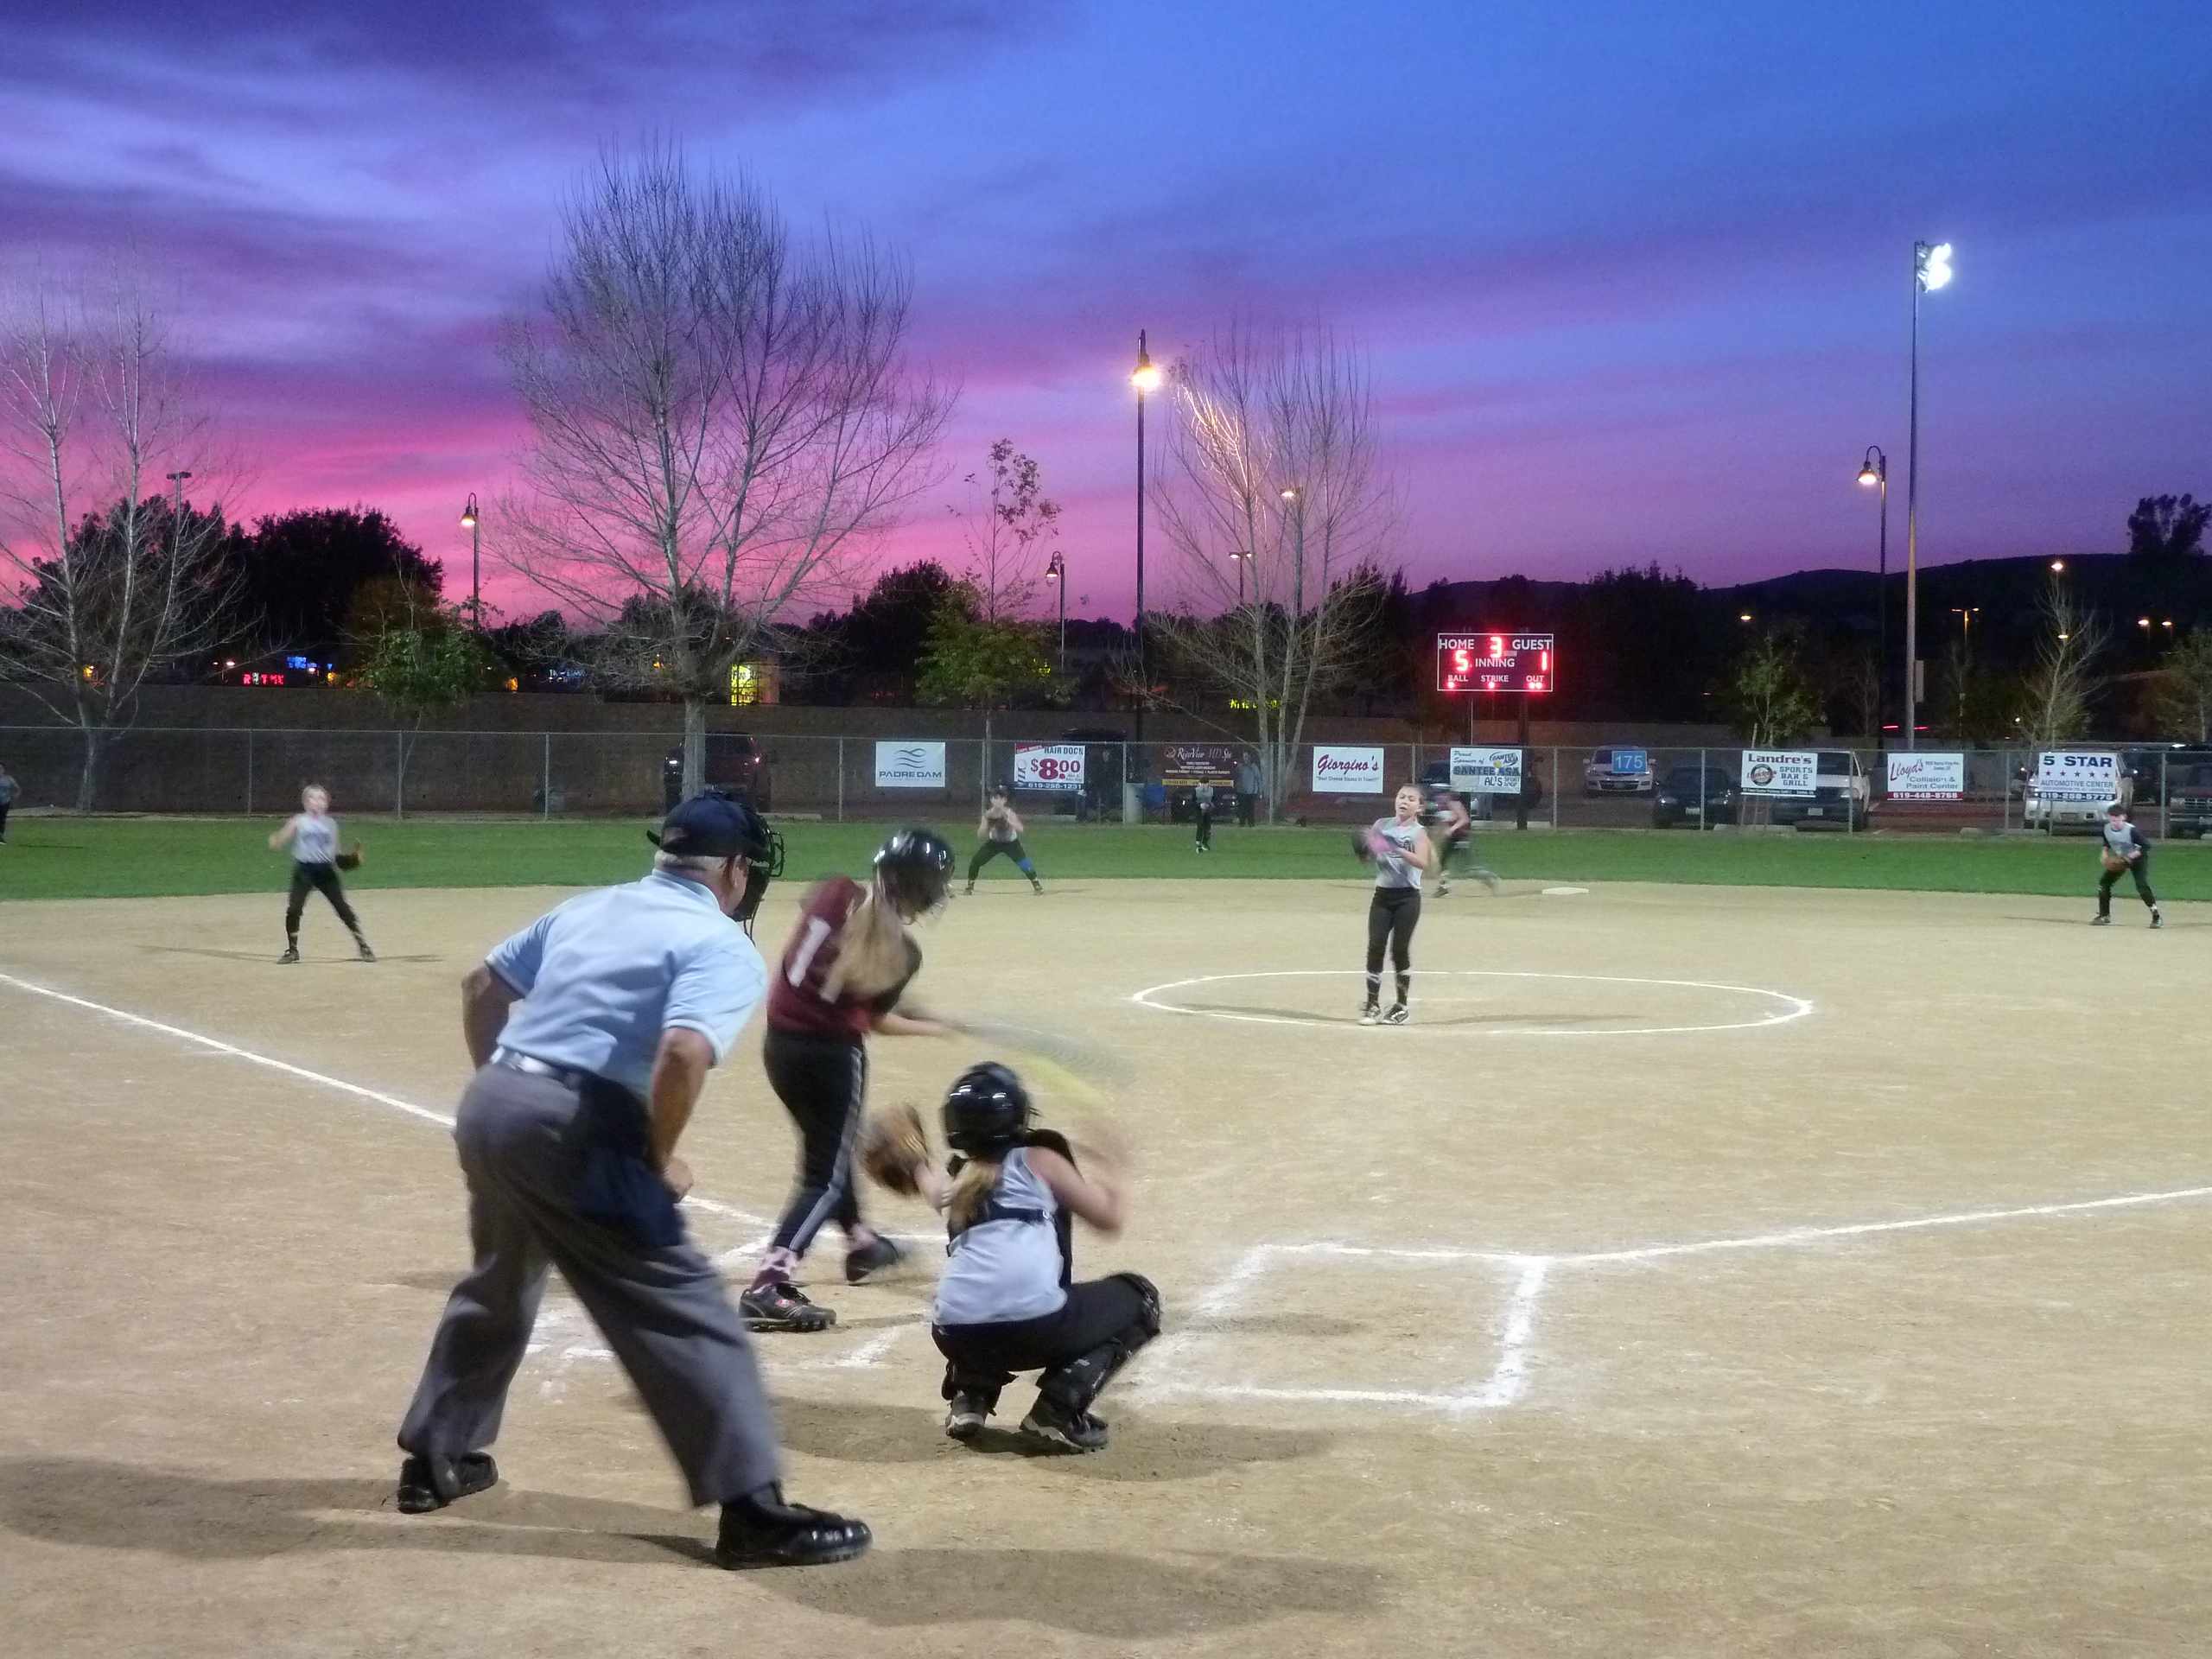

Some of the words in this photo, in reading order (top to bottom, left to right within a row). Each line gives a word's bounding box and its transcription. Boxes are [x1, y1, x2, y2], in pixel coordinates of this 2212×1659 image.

[1439, 639, 1474, 650] HOME
[1490, 636, 1503, 658] 3
[1512, 639, 1551, 650] GUEST
[1455, 649, 1469, 671] 5
[1475, 658, 1515, 667] INNING
[1541, 651, 1547, 671] 1
[1447, 674, 1469, 683] BALL
[1480, 674, 1509, 683] STRIKE
[1318, 753, 1379, 776] Giorgino's
[1615, 755, 1643, 769] 175
[1748, 753, 1812, 765] Landre's
[2043, 755, 2056, 766] 5
[2063, 755, 2113, 768] STAR
[1031, 758, 1081, 780] $8.00
[1889, 759, 1923, 782] Lloyd's
[1484, 777, 1503, 786] AL'S
